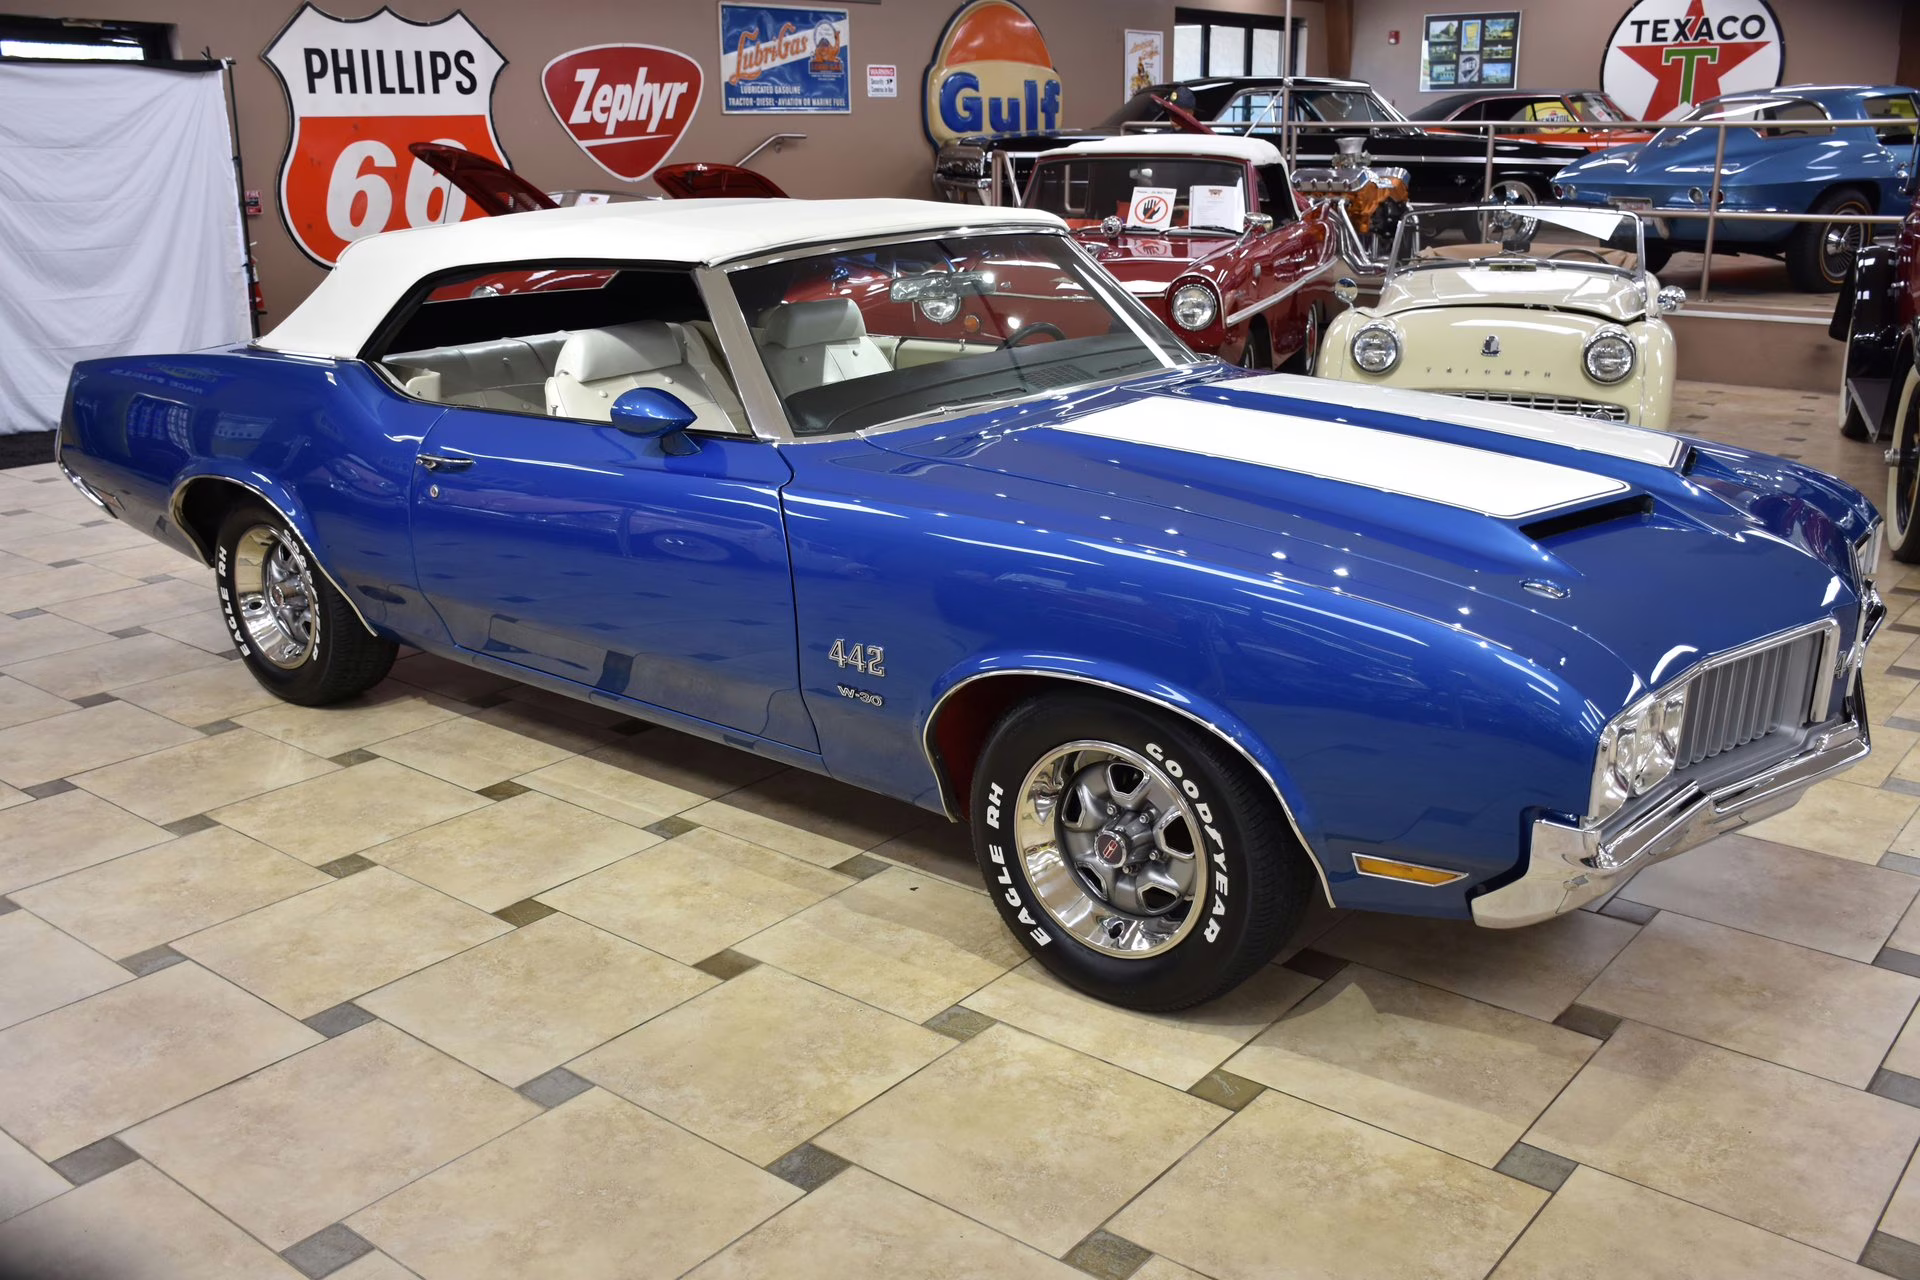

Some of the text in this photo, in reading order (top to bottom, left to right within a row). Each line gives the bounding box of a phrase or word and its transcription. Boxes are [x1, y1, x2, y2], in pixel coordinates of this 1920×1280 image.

[1630, 14, 1766, 44] TEXACO
[304, 47, 478, 95] PHILLIPS
[740, 85, 801, 95] LUBRICATED GASOLINE
[870, 68, 894, 76] WARNING
[1662, 46, 1719, 104] T
[568, 66, 689, 136] Zephyr
[729, 97, 845, 106] TRACTOR DIESEL AVIATION OR MARINE FUEL
[940, 71, 1060, 137] Gulf
[326, 138, 468, 243] 66
[1425, 367, 1551, 379] TRIUMPH
[218, 545, 251, 657] EAGLE RH
[828, 638, 885, 677] 442
[837, 684, 883, 706] W-30
[986, 782, 1052, 947] EAGLE RH
[1146, 742, 1229, 943] GOODYEAR
